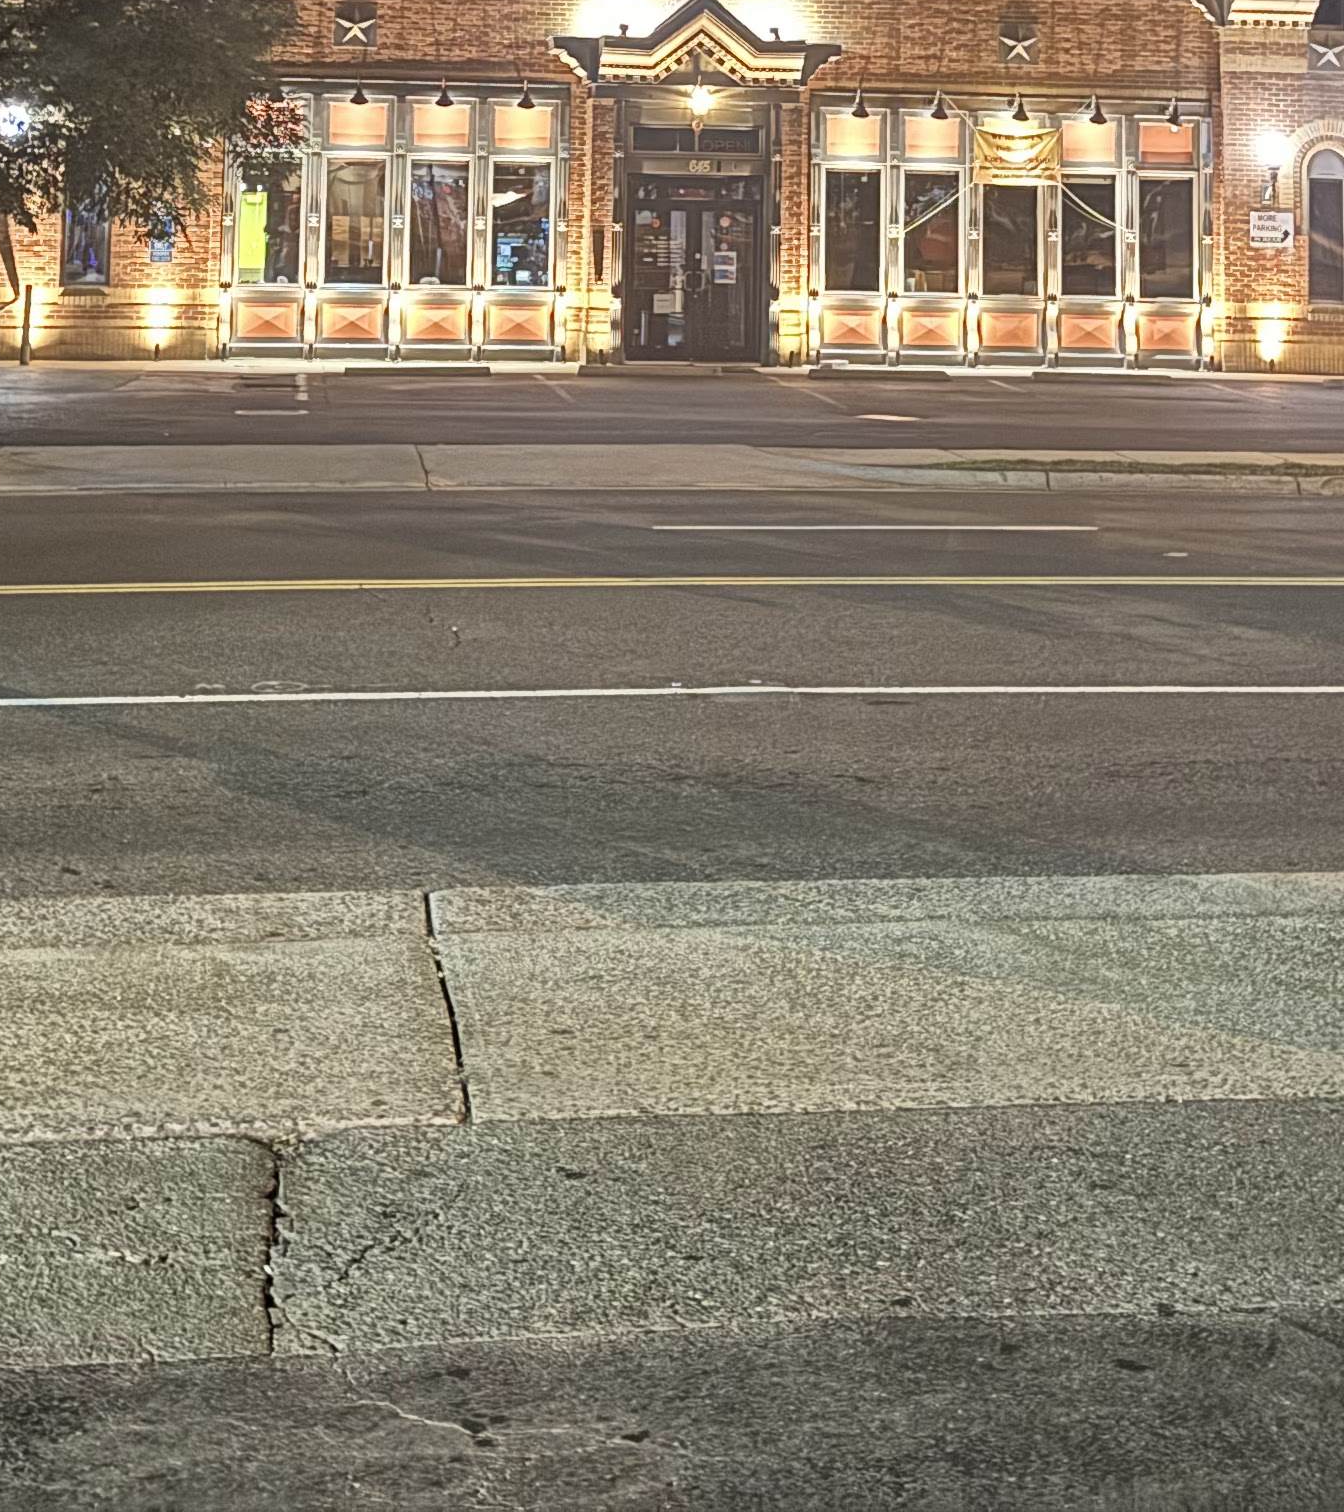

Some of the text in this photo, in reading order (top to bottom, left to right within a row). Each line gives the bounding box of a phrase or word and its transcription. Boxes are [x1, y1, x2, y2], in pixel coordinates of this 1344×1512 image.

[689, 159, 711, 173] 645
[1257, 214, 1278, 222] MORE
[1252, 224, 1283, 232] PARKING
